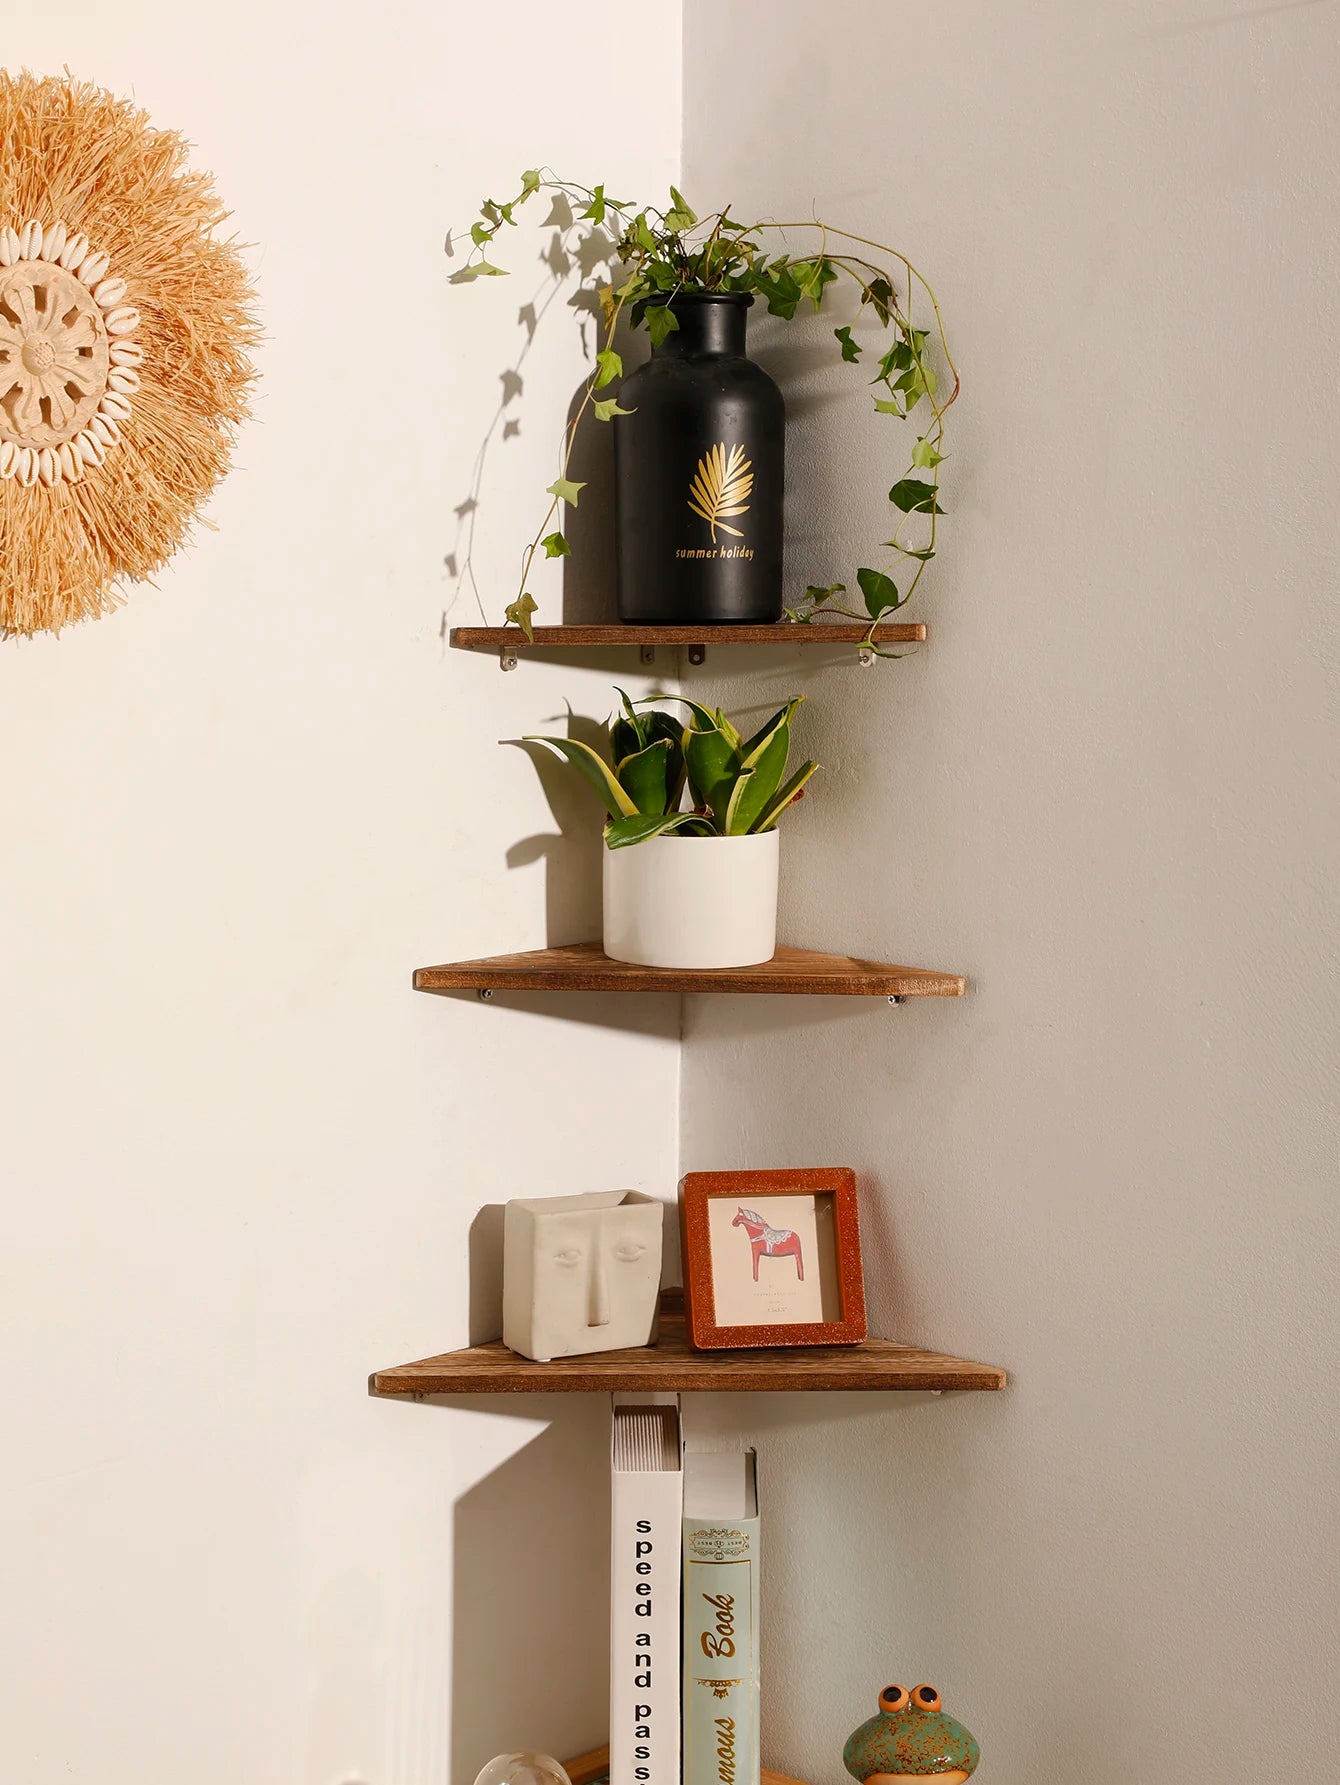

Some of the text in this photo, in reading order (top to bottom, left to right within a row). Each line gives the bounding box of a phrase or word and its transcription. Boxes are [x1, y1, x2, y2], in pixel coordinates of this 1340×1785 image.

[676, 546, 754, 560] summer holiday
[635, 1520, 653, 1785] speed and pass
[700, 1594, 736, 1659] Book
